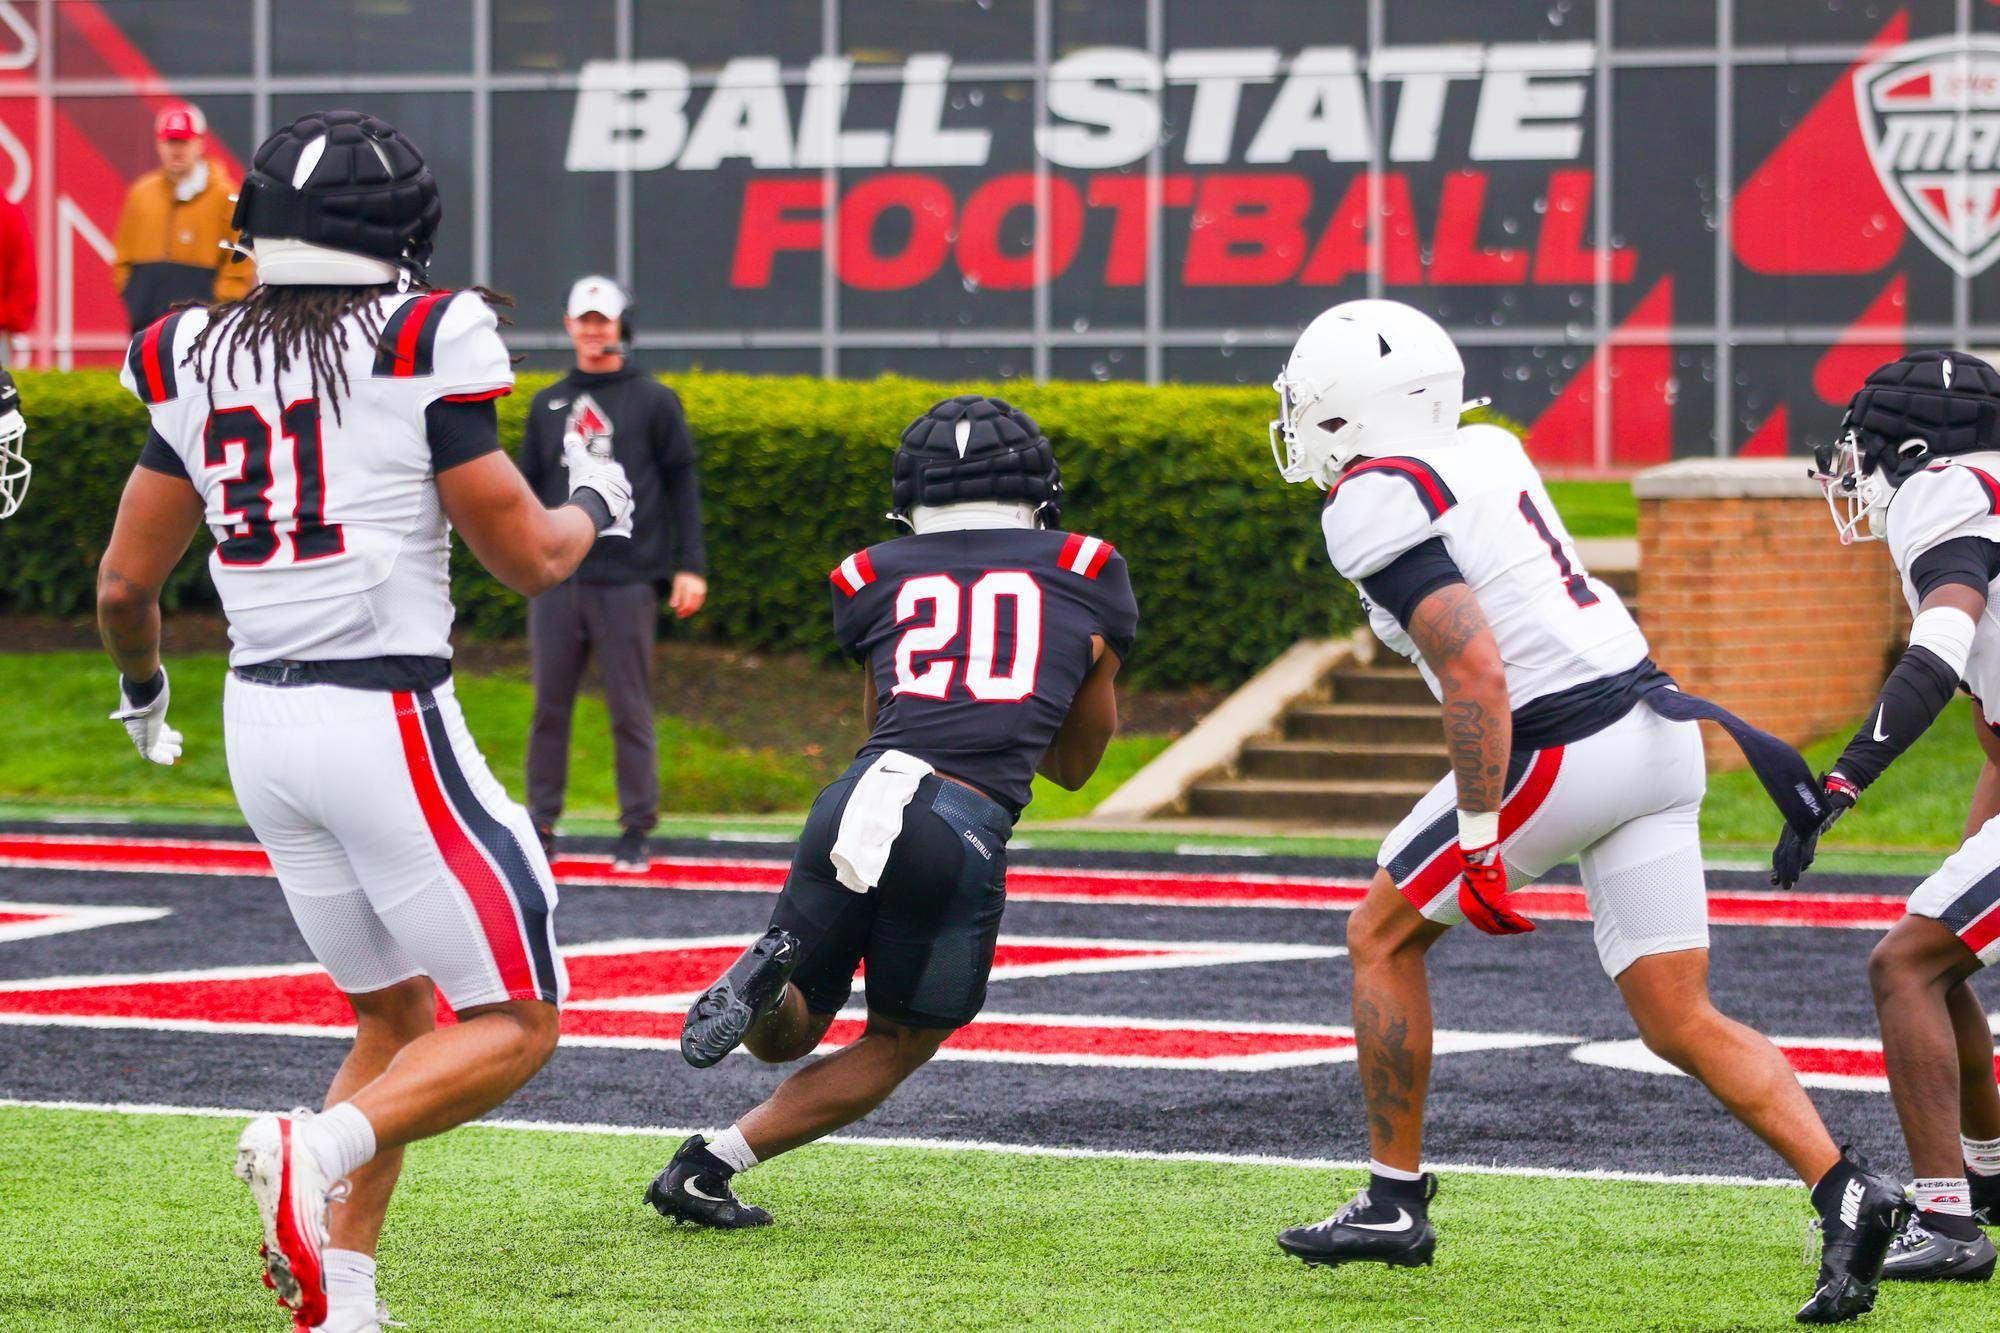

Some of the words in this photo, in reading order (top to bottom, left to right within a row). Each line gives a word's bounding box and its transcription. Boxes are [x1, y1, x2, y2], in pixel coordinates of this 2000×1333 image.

[564, 54, 993, 172] BALL
[1034, 41, 1597, 169] STATE
[730, 168, 1638, 291] FOOTBALL
[203, 397, 346, 567] 31
[1518, 490, 1601, 609] 1
[890, 569, 1045, 704] 20
[963, 829, 993, 861] CARDINALS
[1839, 1178, 1867, 1231] NIKE
